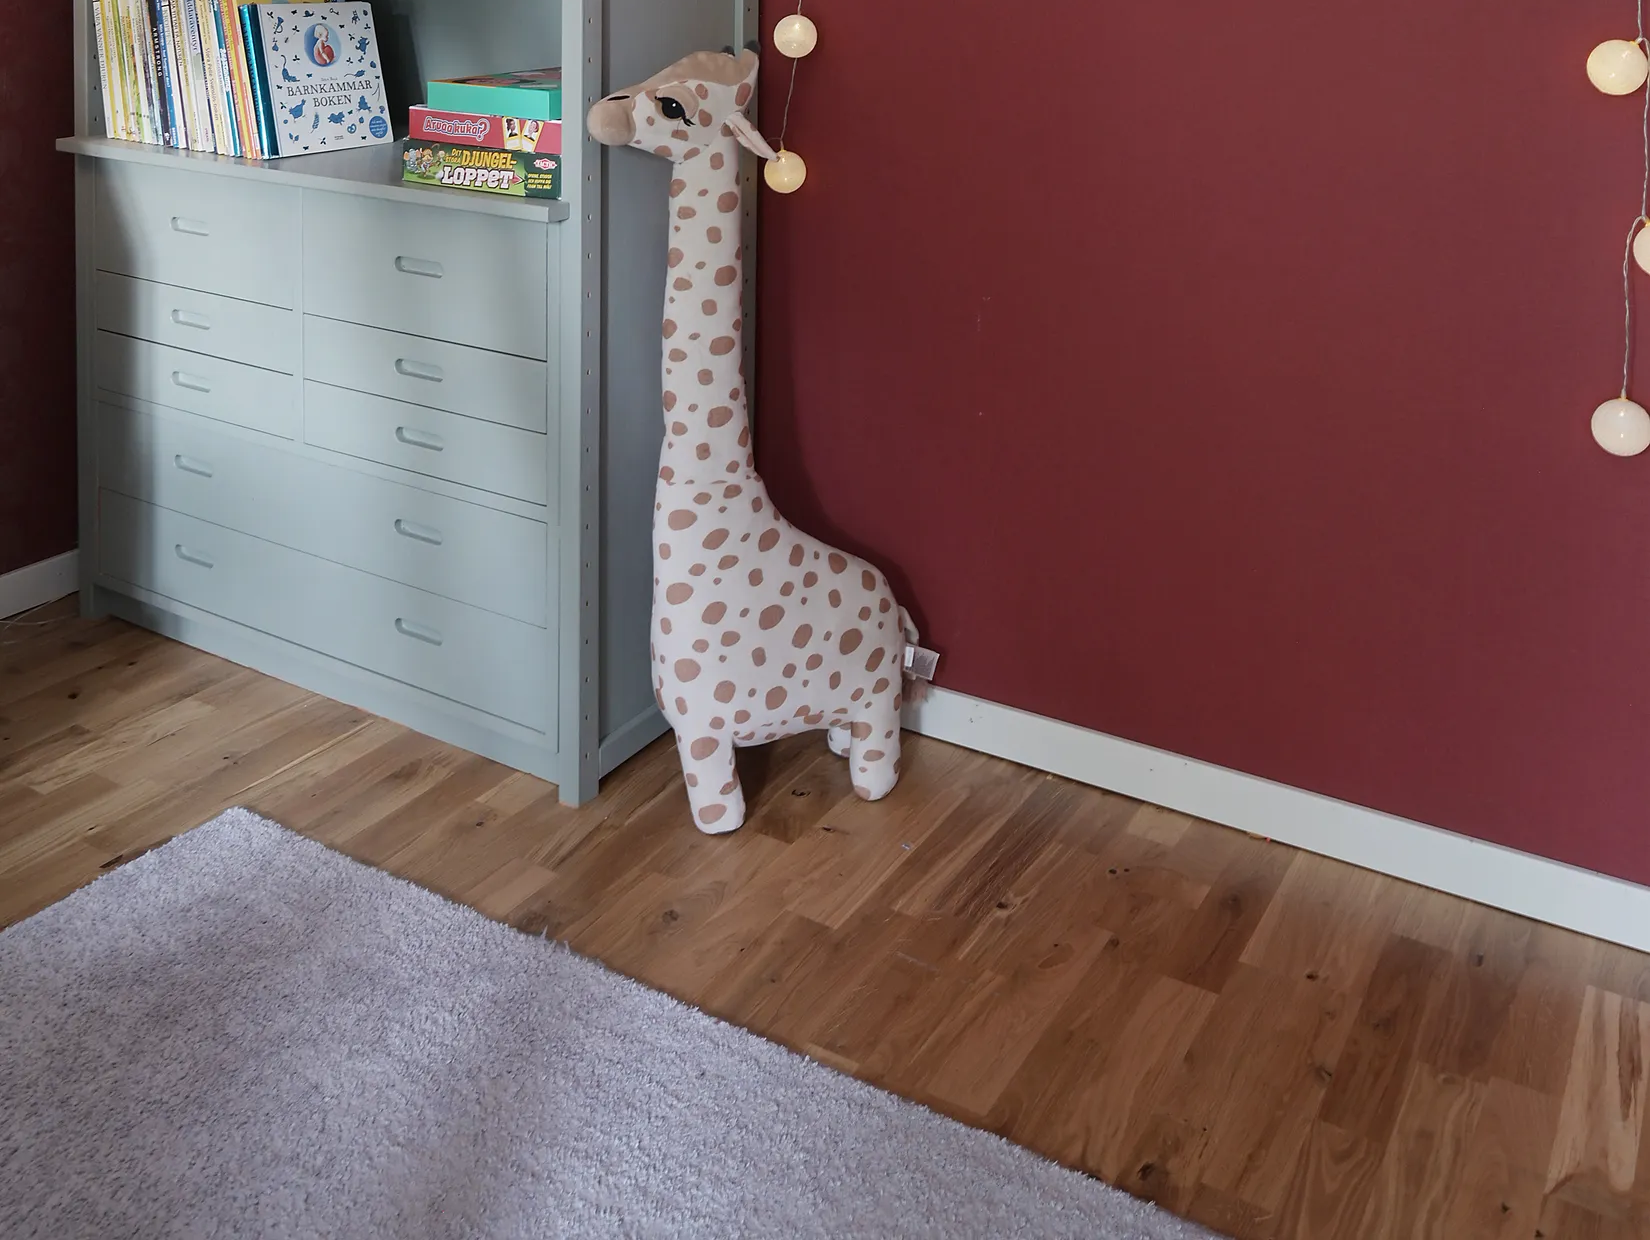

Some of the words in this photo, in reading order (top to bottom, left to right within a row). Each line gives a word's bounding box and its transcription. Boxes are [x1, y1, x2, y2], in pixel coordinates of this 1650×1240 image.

[94, 7, 102, 27] VÅRA
[162, 9, 172, 45] KROPPEN
[96, 28, 105, 58] VÄNNER
[151, 27, 162, 76] ARMSTRONG
[99, 60, 108, 89] DJUREN
[286, 80, 372, 97] BARNKAMMAR
[313, 94, 352, 107] BOKEN
[424, 118, 453, 133] Arvaa
[453, 120, 488, 140] kuka?
[462, 150, 517, 168] DJUNGEL-
